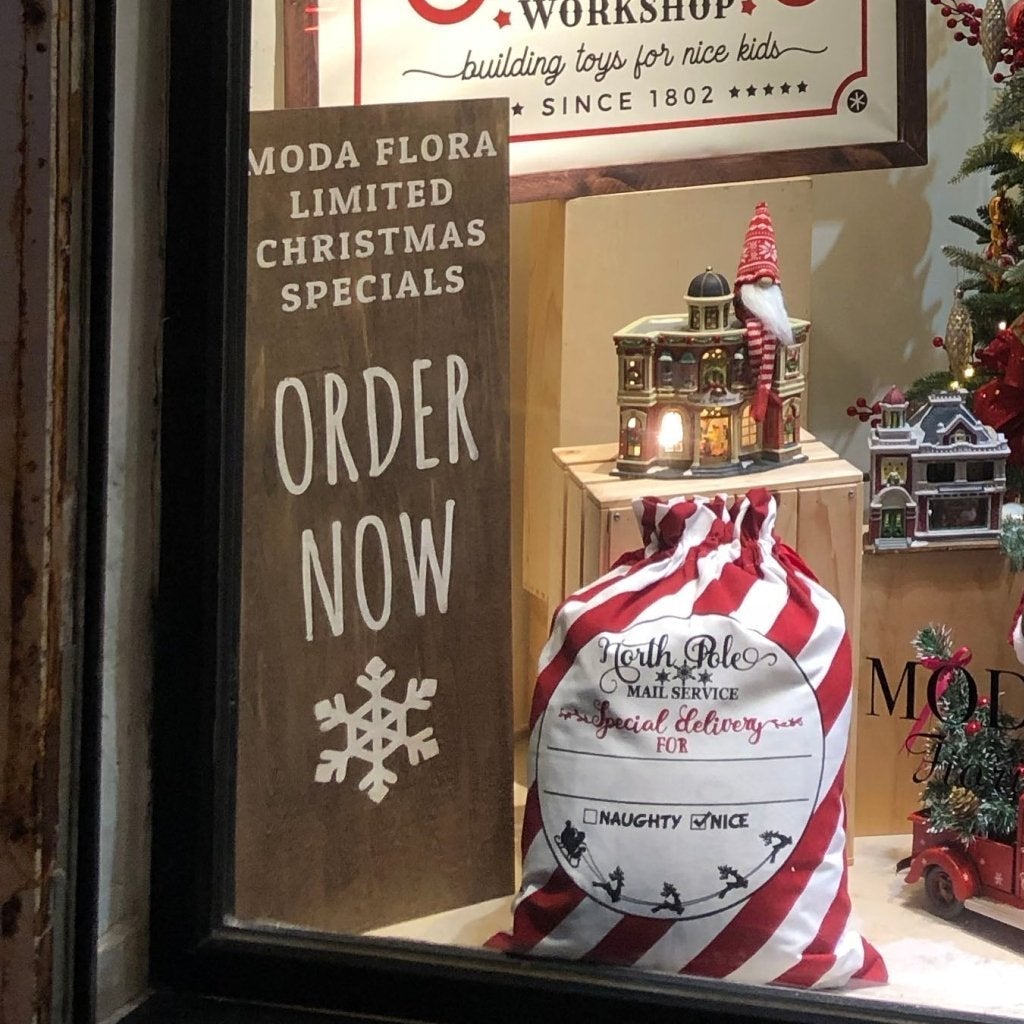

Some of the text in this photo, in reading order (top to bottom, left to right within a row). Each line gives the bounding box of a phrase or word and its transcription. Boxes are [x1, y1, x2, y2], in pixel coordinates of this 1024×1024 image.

[456, 31, 795, 86] building toys for nice kids
[541, 86, 715, 116] SINCE 1802
[248, 130, 498, 176] MODA FLORA
[289, 178, 453, 219] LIMITED
[256, 218, 486, 269] CHRISTMAS
[281, 265, 465, 312] SPECIALS
[274, 353, 479, 495] ORDER
[301, 499, 456, 642] NOW
[598, 634, 778, 694] North Pole
[626, 685, 739, 701] MAIL SERVICE
[591, 700, 767, 745] Special delivery
[655, 736, 689, 754] FOR
[599, 811, 750, 830] NAUGHTY NICE
